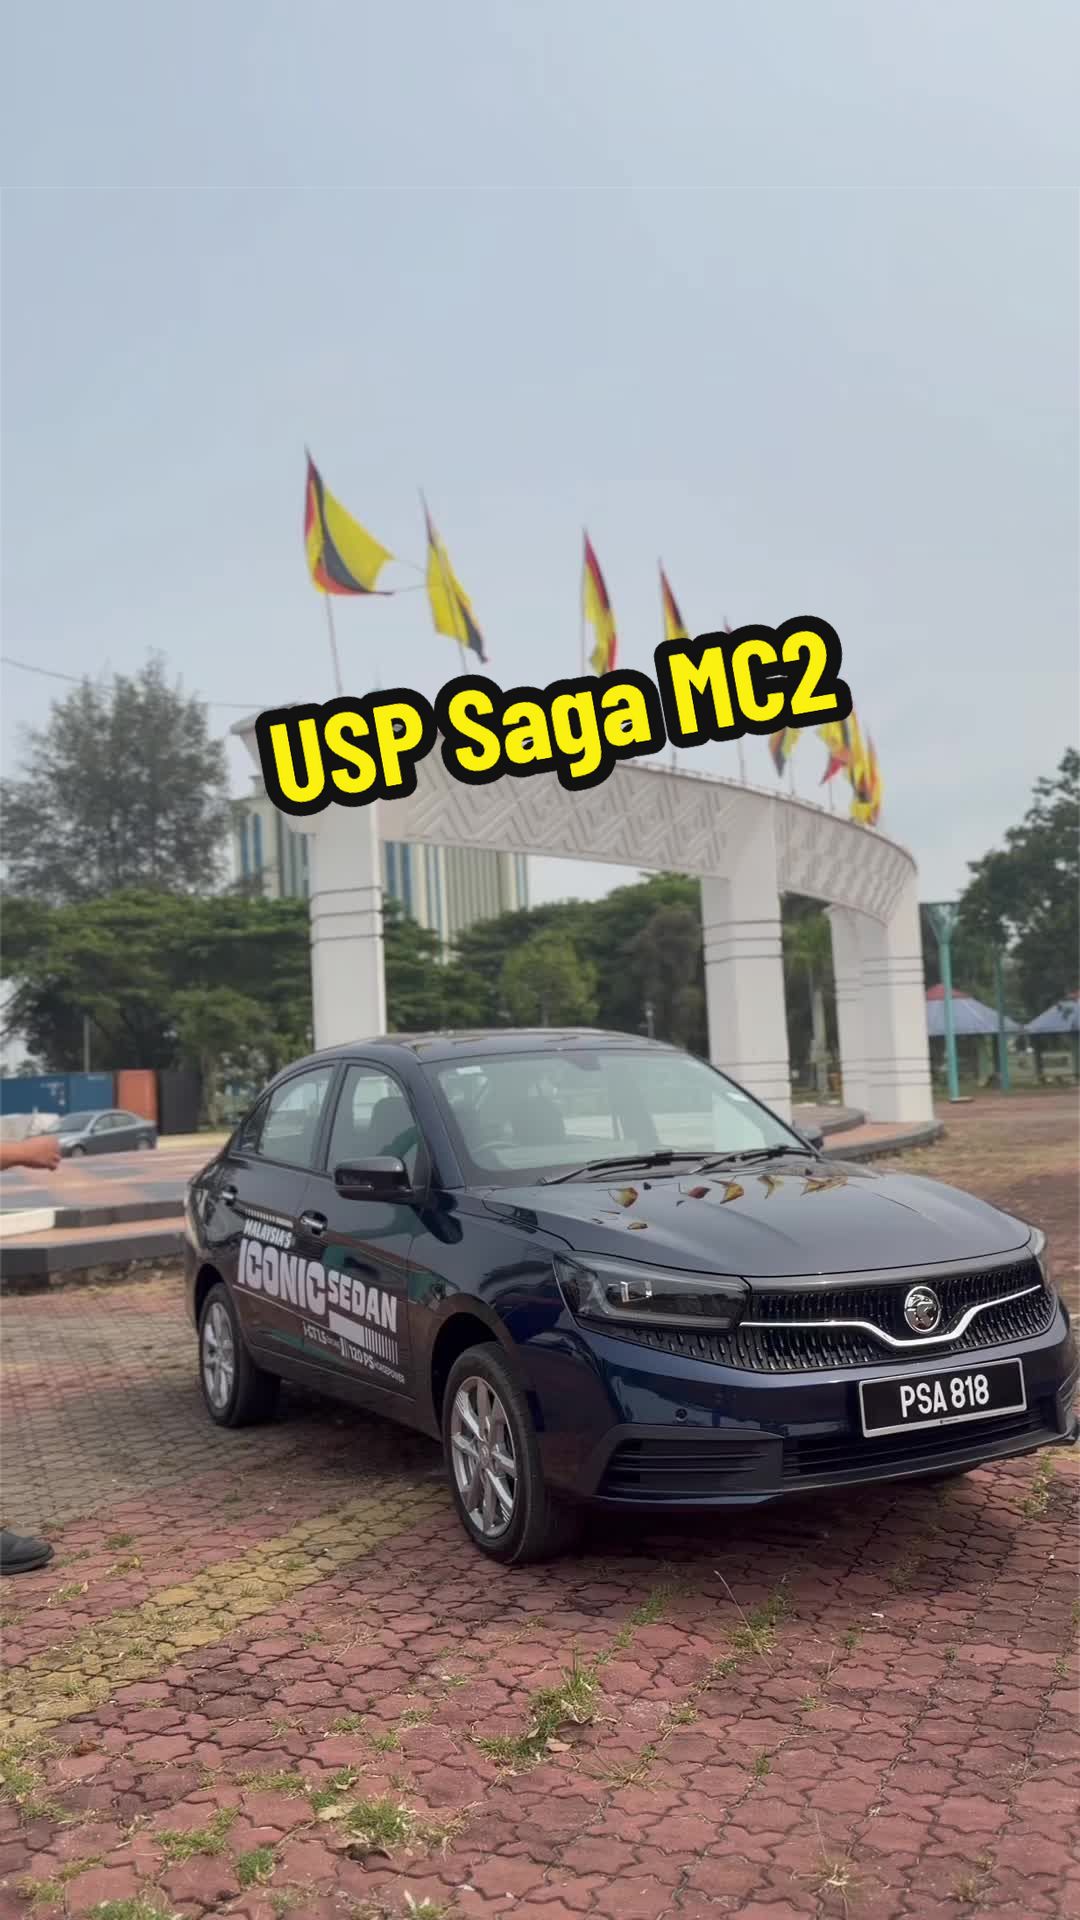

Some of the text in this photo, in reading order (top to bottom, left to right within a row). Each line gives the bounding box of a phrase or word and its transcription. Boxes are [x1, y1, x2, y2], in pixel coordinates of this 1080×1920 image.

[243, 1219, 292, 1249] MALAYSIA'S
[237, 1238, 398, 1333] ICONIC SEDAN
[899, 1374, 990, 1418] PSA 818
